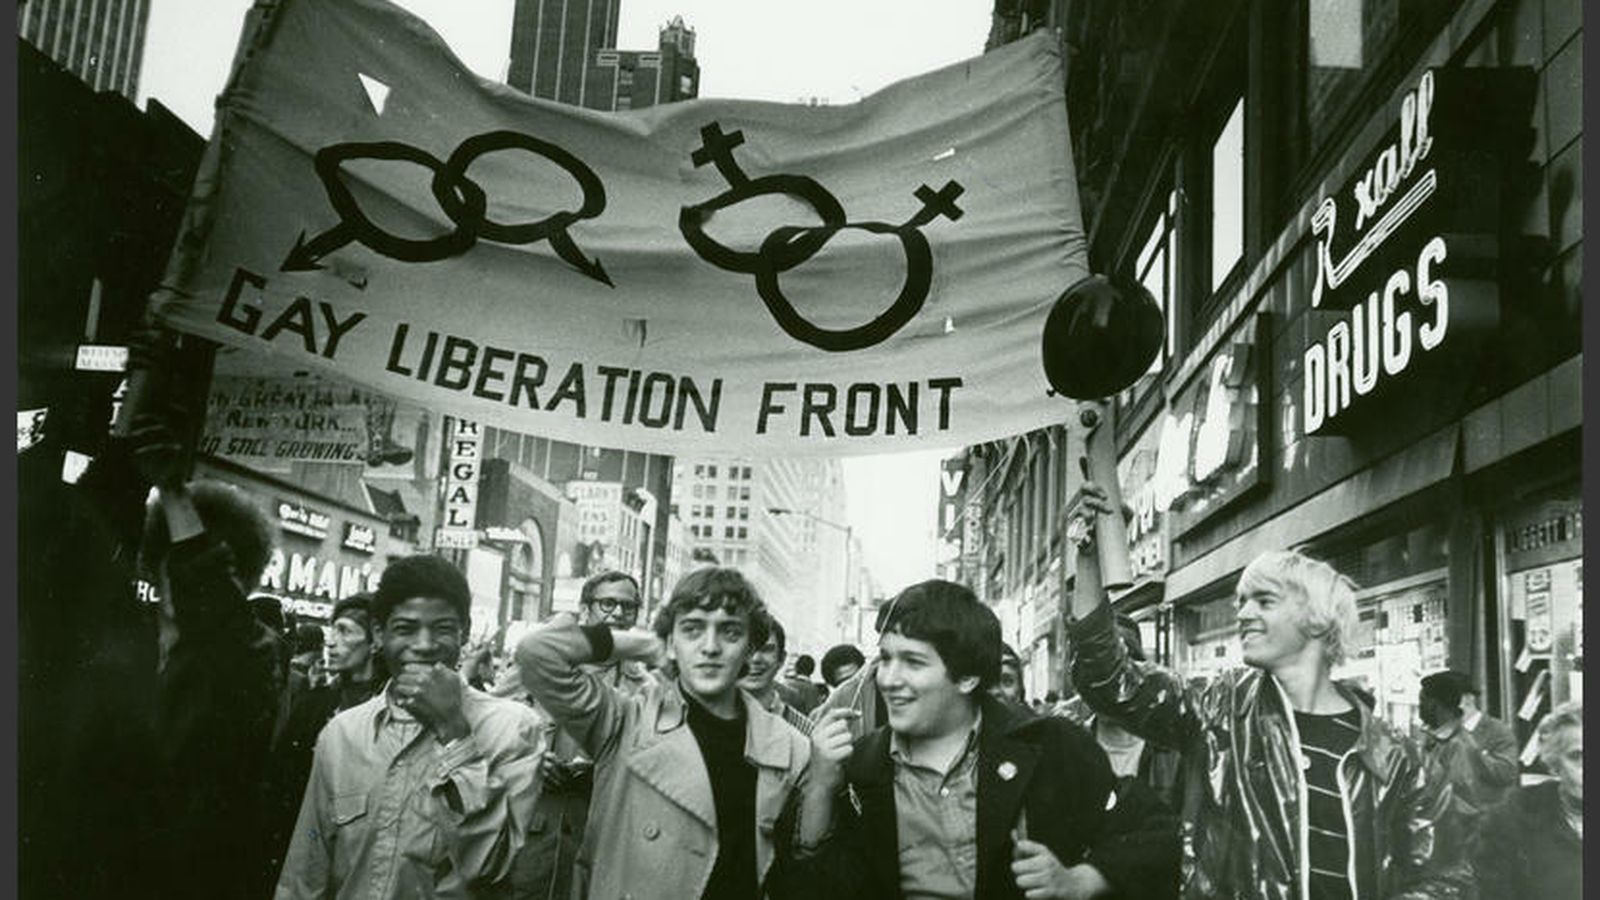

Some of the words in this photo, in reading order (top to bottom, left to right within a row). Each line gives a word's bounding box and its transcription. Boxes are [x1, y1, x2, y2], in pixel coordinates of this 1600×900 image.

[216, 267, 368, 359] GAY
[385, 323, 723, 433] LIBERATION
[756, 377, 963, 437] FRONT
[1303, 236, 1449, 434] DRUGS
[225, 437, 267, 456] STILL
[448, 419, 477, 527] REGAL
